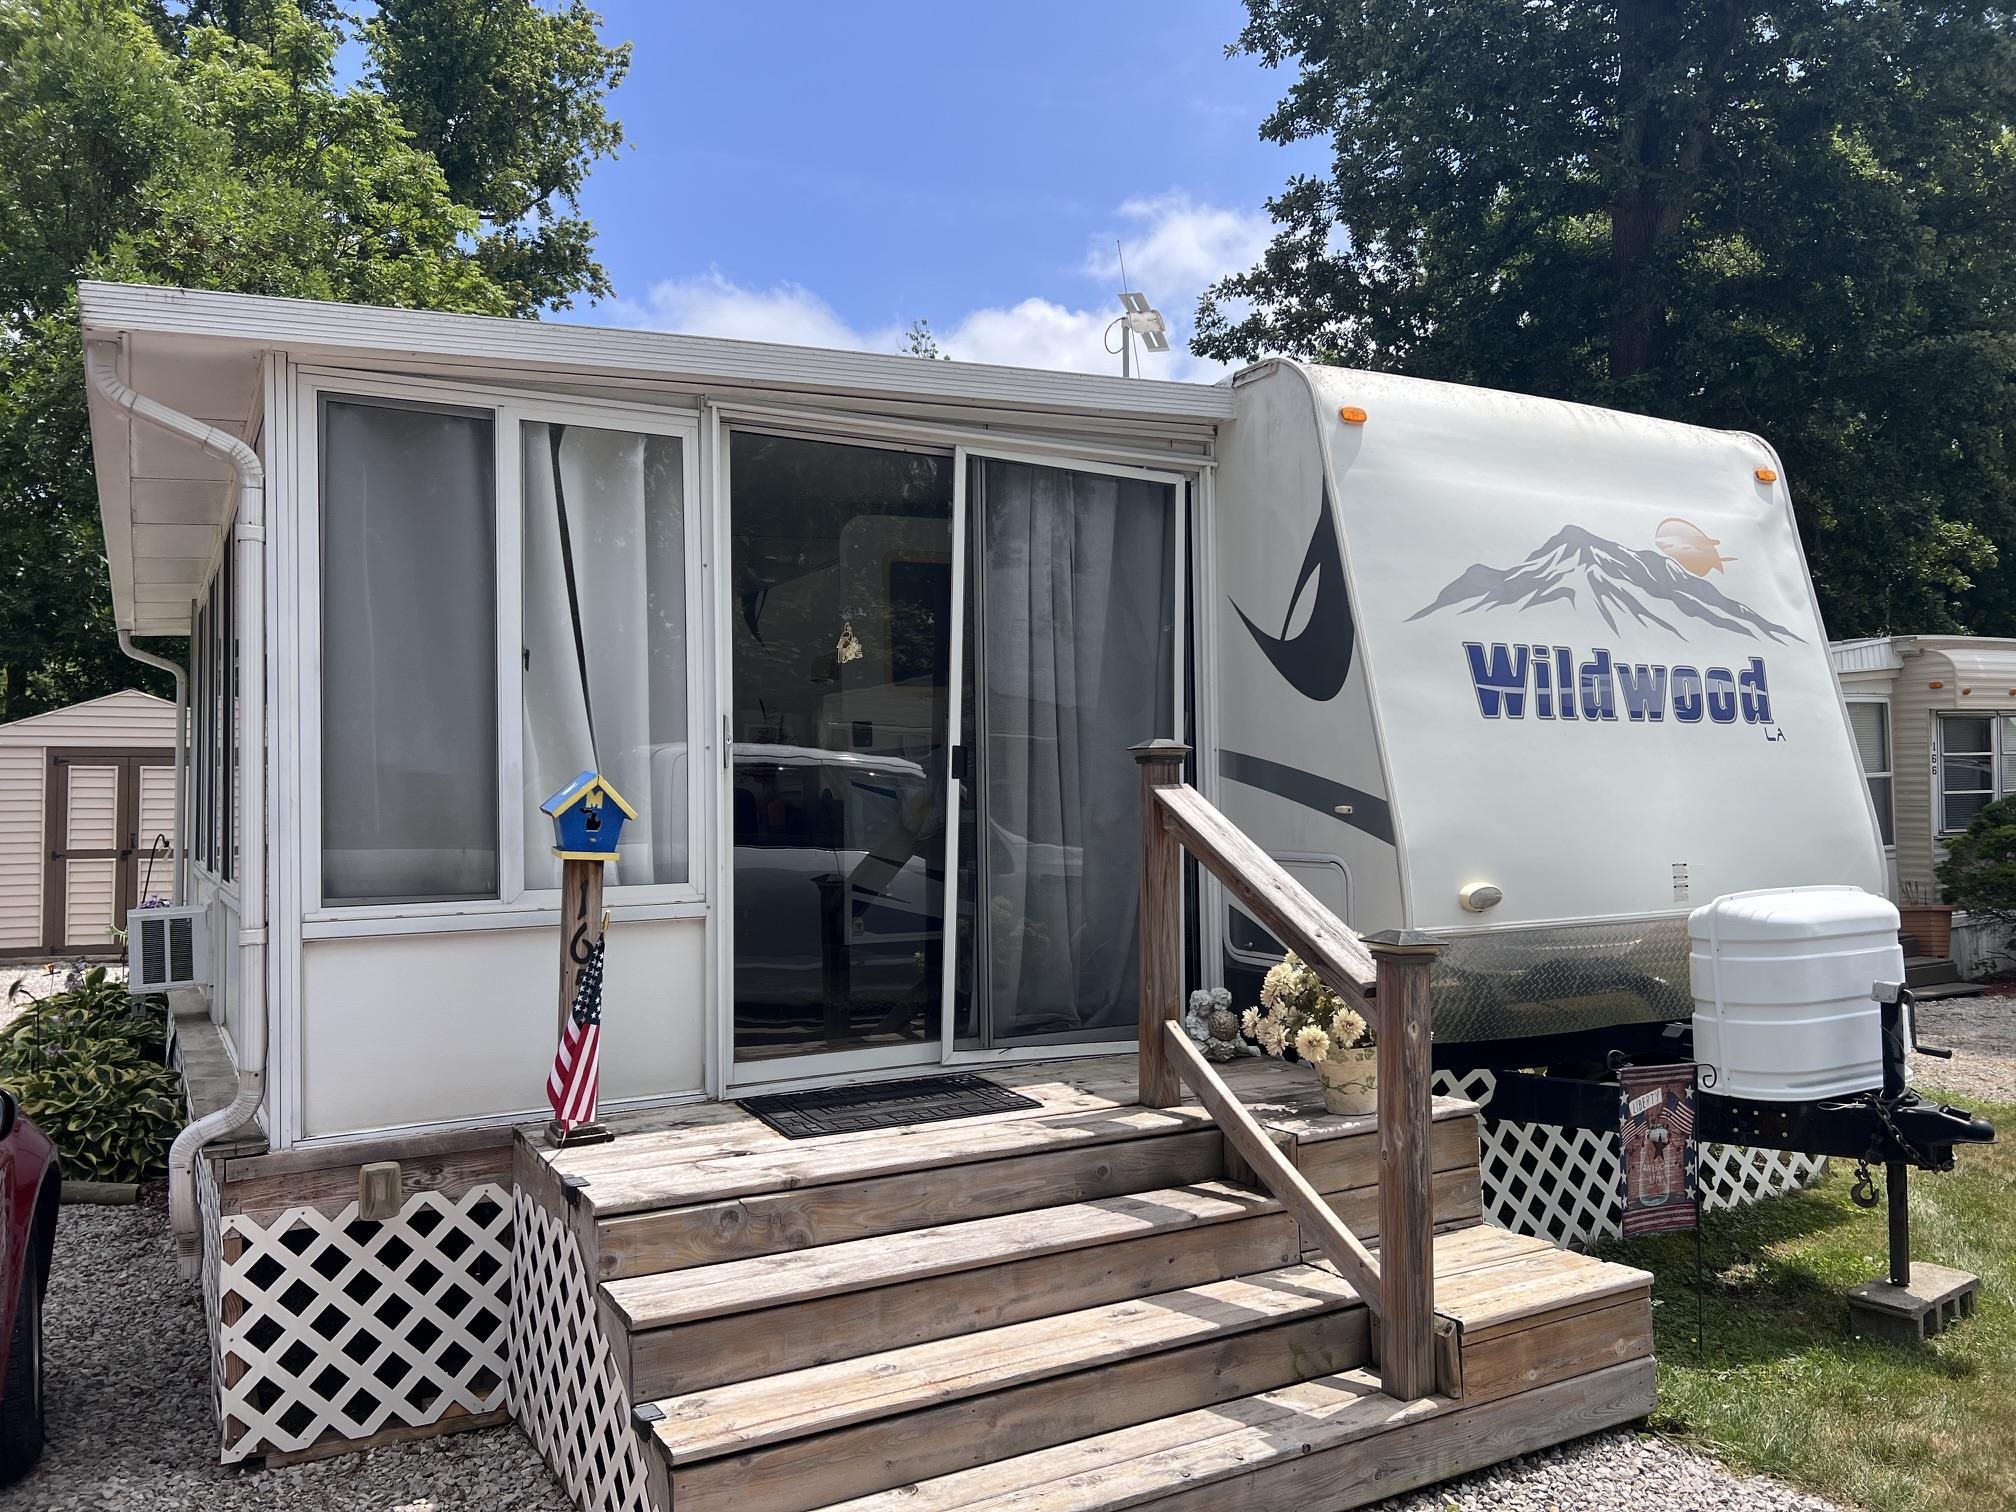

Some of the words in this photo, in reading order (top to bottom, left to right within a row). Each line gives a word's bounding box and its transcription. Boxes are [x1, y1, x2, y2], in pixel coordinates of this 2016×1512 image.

[1462, 641, 1774, 725] Wildwood
[1764, 727, 1786, 742] LA
[584, 790, 605, 809] M
[1632, 1090, 1660, 1114] LIBERTY
